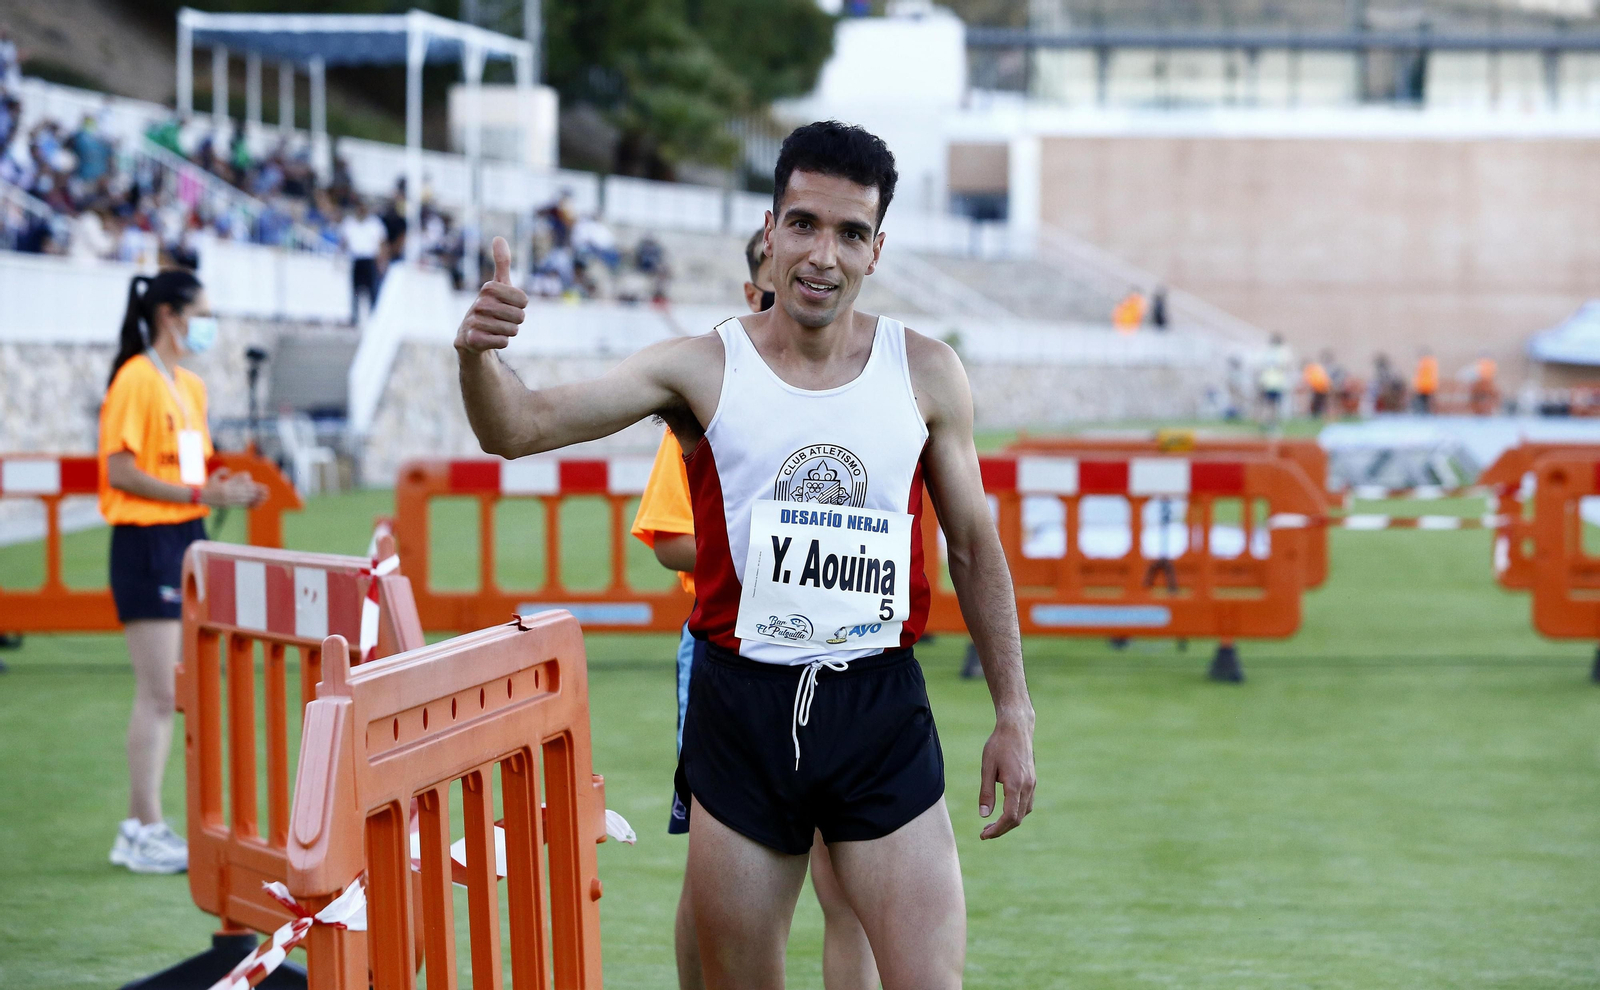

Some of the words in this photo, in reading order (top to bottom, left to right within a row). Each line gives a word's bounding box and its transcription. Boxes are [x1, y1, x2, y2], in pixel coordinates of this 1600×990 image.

[784, 452, 807, 476] CLUB
[809, 446, 861, 476] ATLETISMO
[780, 508, 843, 528] DESAFÍO
[847, 514, 889, 534] NERJA
[771, 535, 793, 584] Y.
[799, 539, 896, 596] Aouina
[769, 615, 787, 626] Bar
[879, 598, 894, 621] 5
